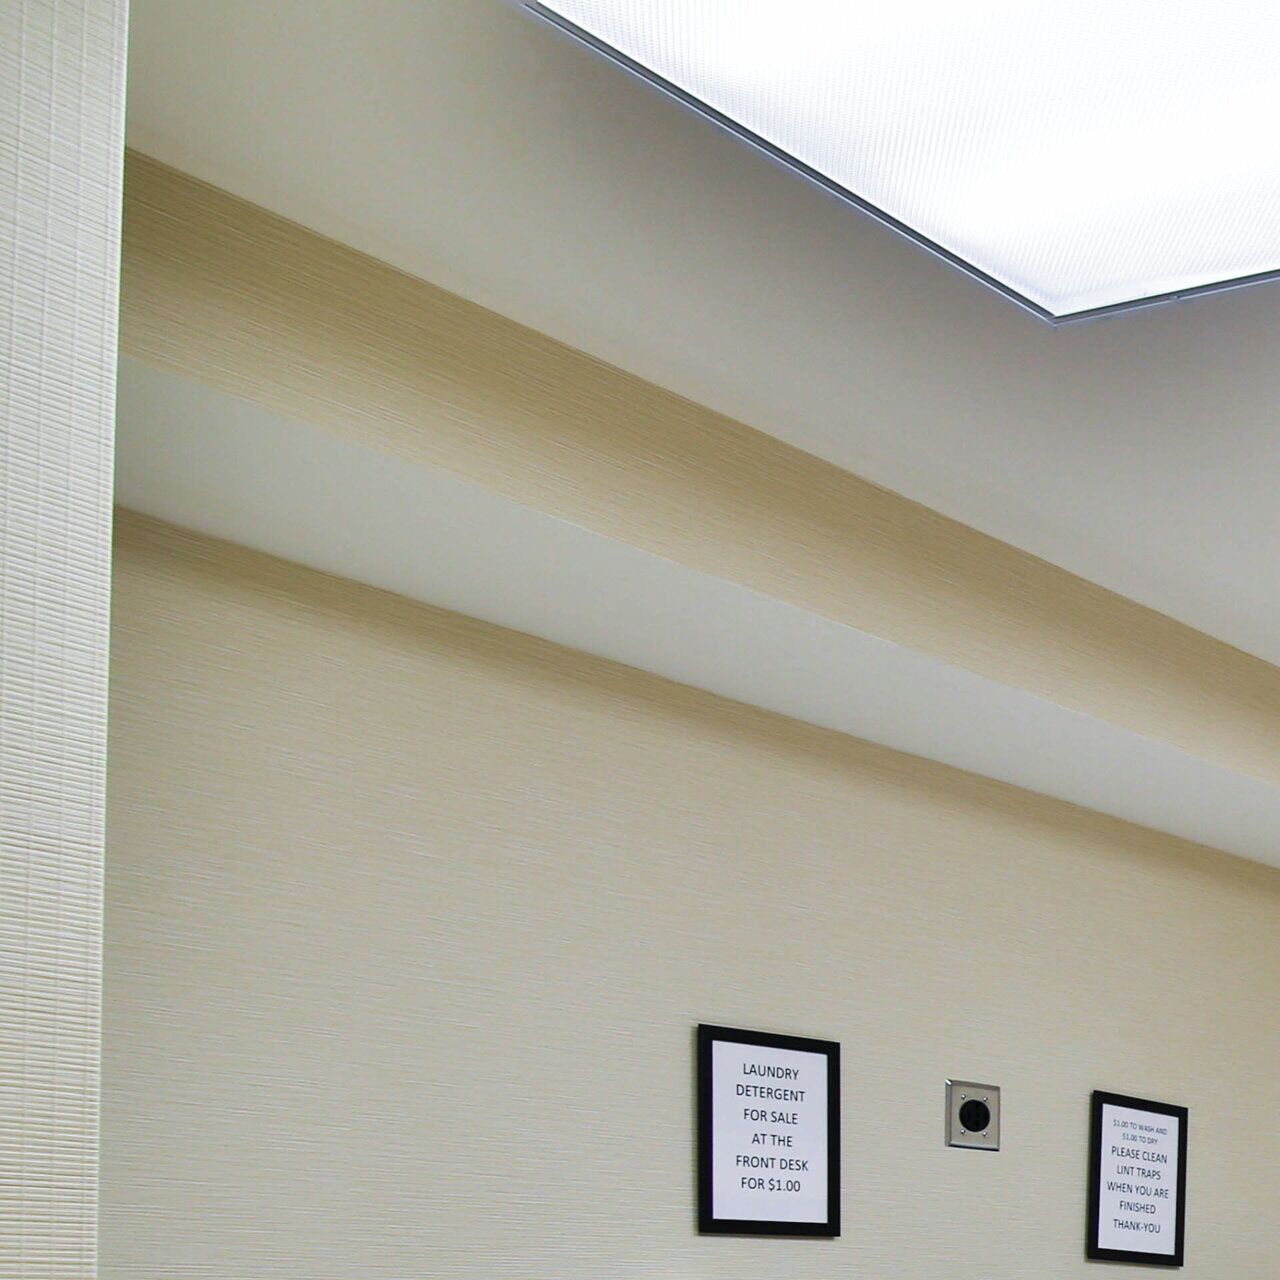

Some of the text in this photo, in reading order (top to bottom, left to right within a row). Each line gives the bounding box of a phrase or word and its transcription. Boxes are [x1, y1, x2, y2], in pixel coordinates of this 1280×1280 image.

[743, 1063, 800, 1080] LAUNDRY
[736, 1083, 806, 1102] DETERGENT
[743, 1108, 799, 1125] FOR SALE
[1130, 1120, 1138, 1130] TO
[1138, 1122, 1155, 1133] WASH
[1155, 1125, 1168, 1135] AND
[751, 1133, 793, 1147] AT THE
[1138, 1134, 1147, 1143] TO
[1147, 1135, 1159, 1145] DRY
[1111, 1146, 1168, 1164] PLEASE CLEAN
[736, 1155, 809, 1172] FRONT DESK
[1116, 1164, 1161, 1180] LINT TRAPS
[741, 1177, 801, 1192] FOR $1.00
[1107, 1181, 1169, 1199] WHEN YOU ARE
[1119, 1200, 1156, 1214] FINISHED
[1113, 1218, 1161, 1234] THANK-YOU
